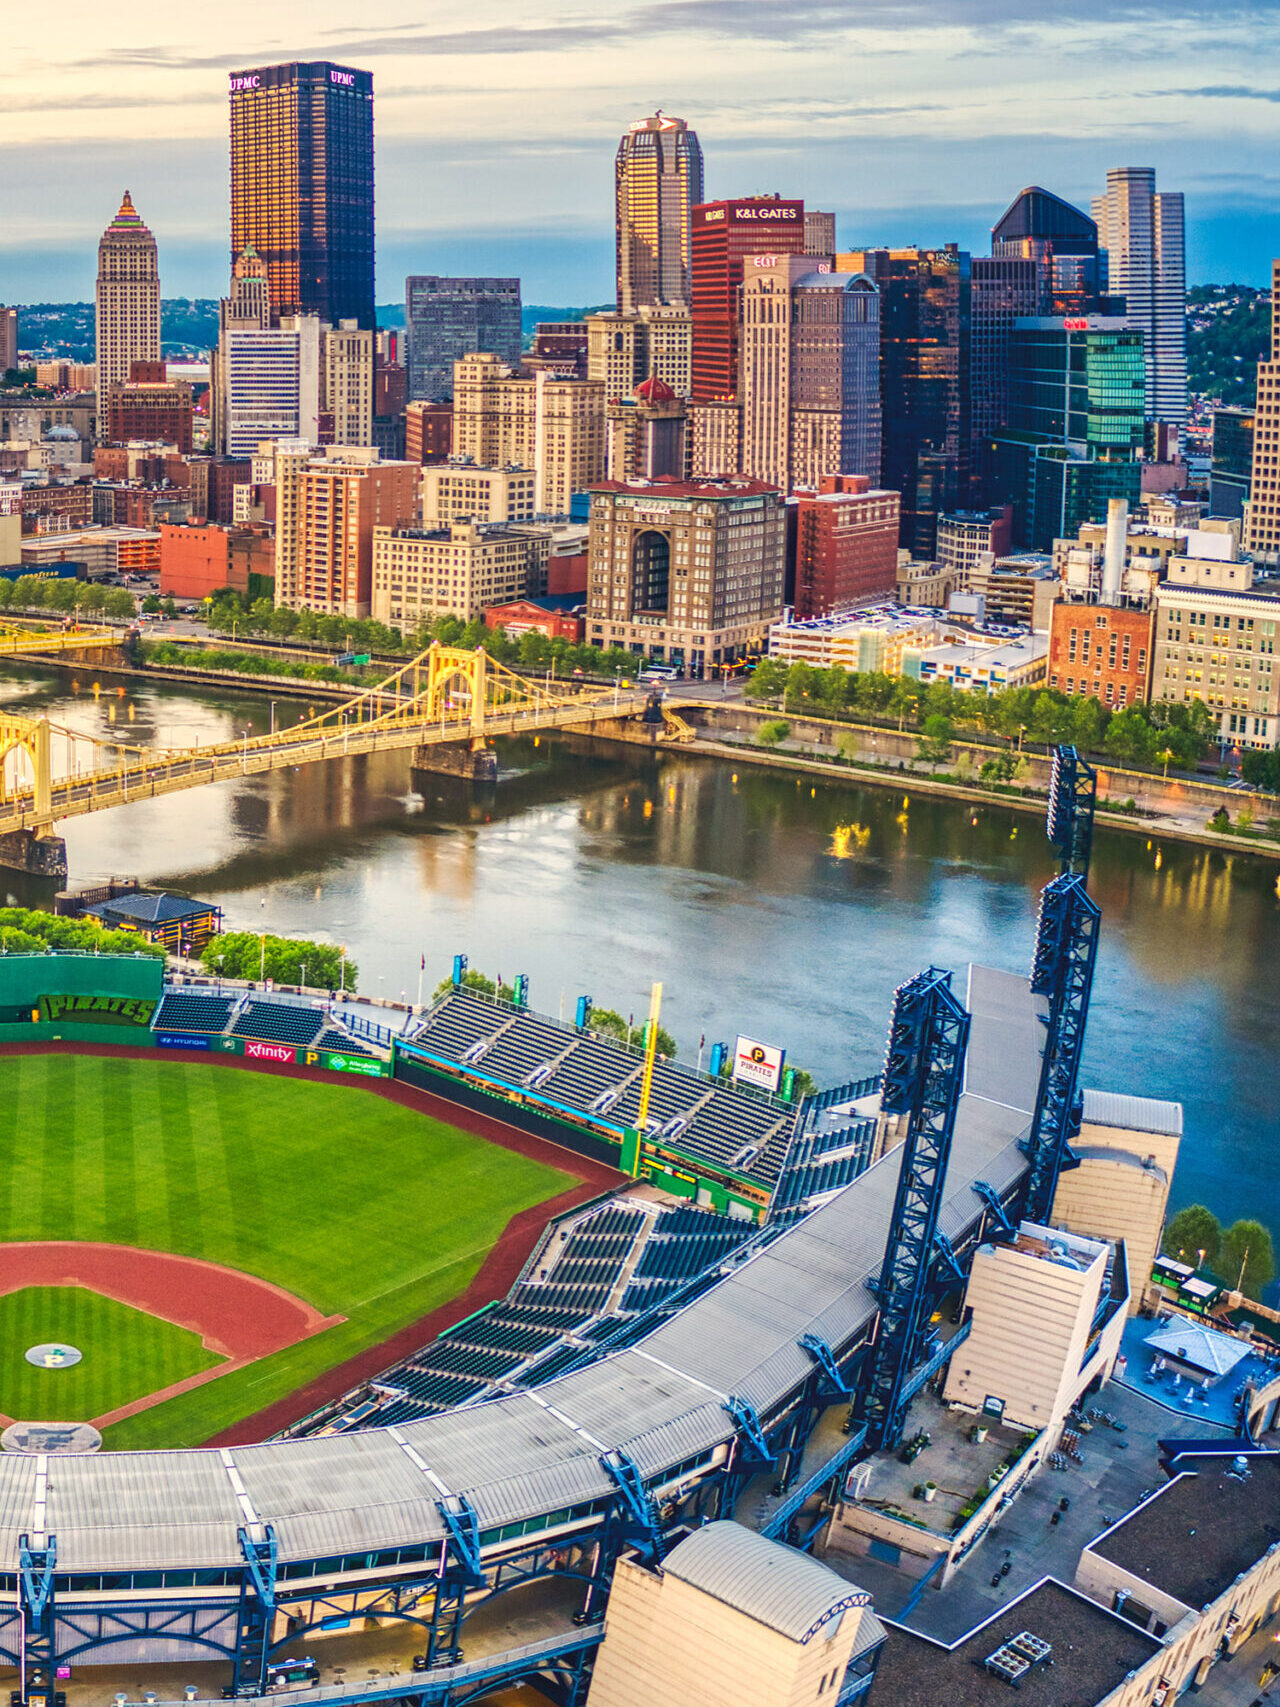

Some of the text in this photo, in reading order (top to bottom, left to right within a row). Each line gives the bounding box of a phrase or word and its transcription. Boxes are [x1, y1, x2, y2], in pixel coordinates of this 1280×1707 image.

[229, 75, 260, 91] UPMC
[330, 70, 355, 86] UPMC
[736, 208, 797, 219] K&L GATES
[46, 995, 153, 1024] PIRATES
[248, 1043, 293, 1062] xfinity
[306, 1052, 319, 1066] P
[754, 1049, 764, 1061] P
[740, 1061, 773, 1078] PIRATES
